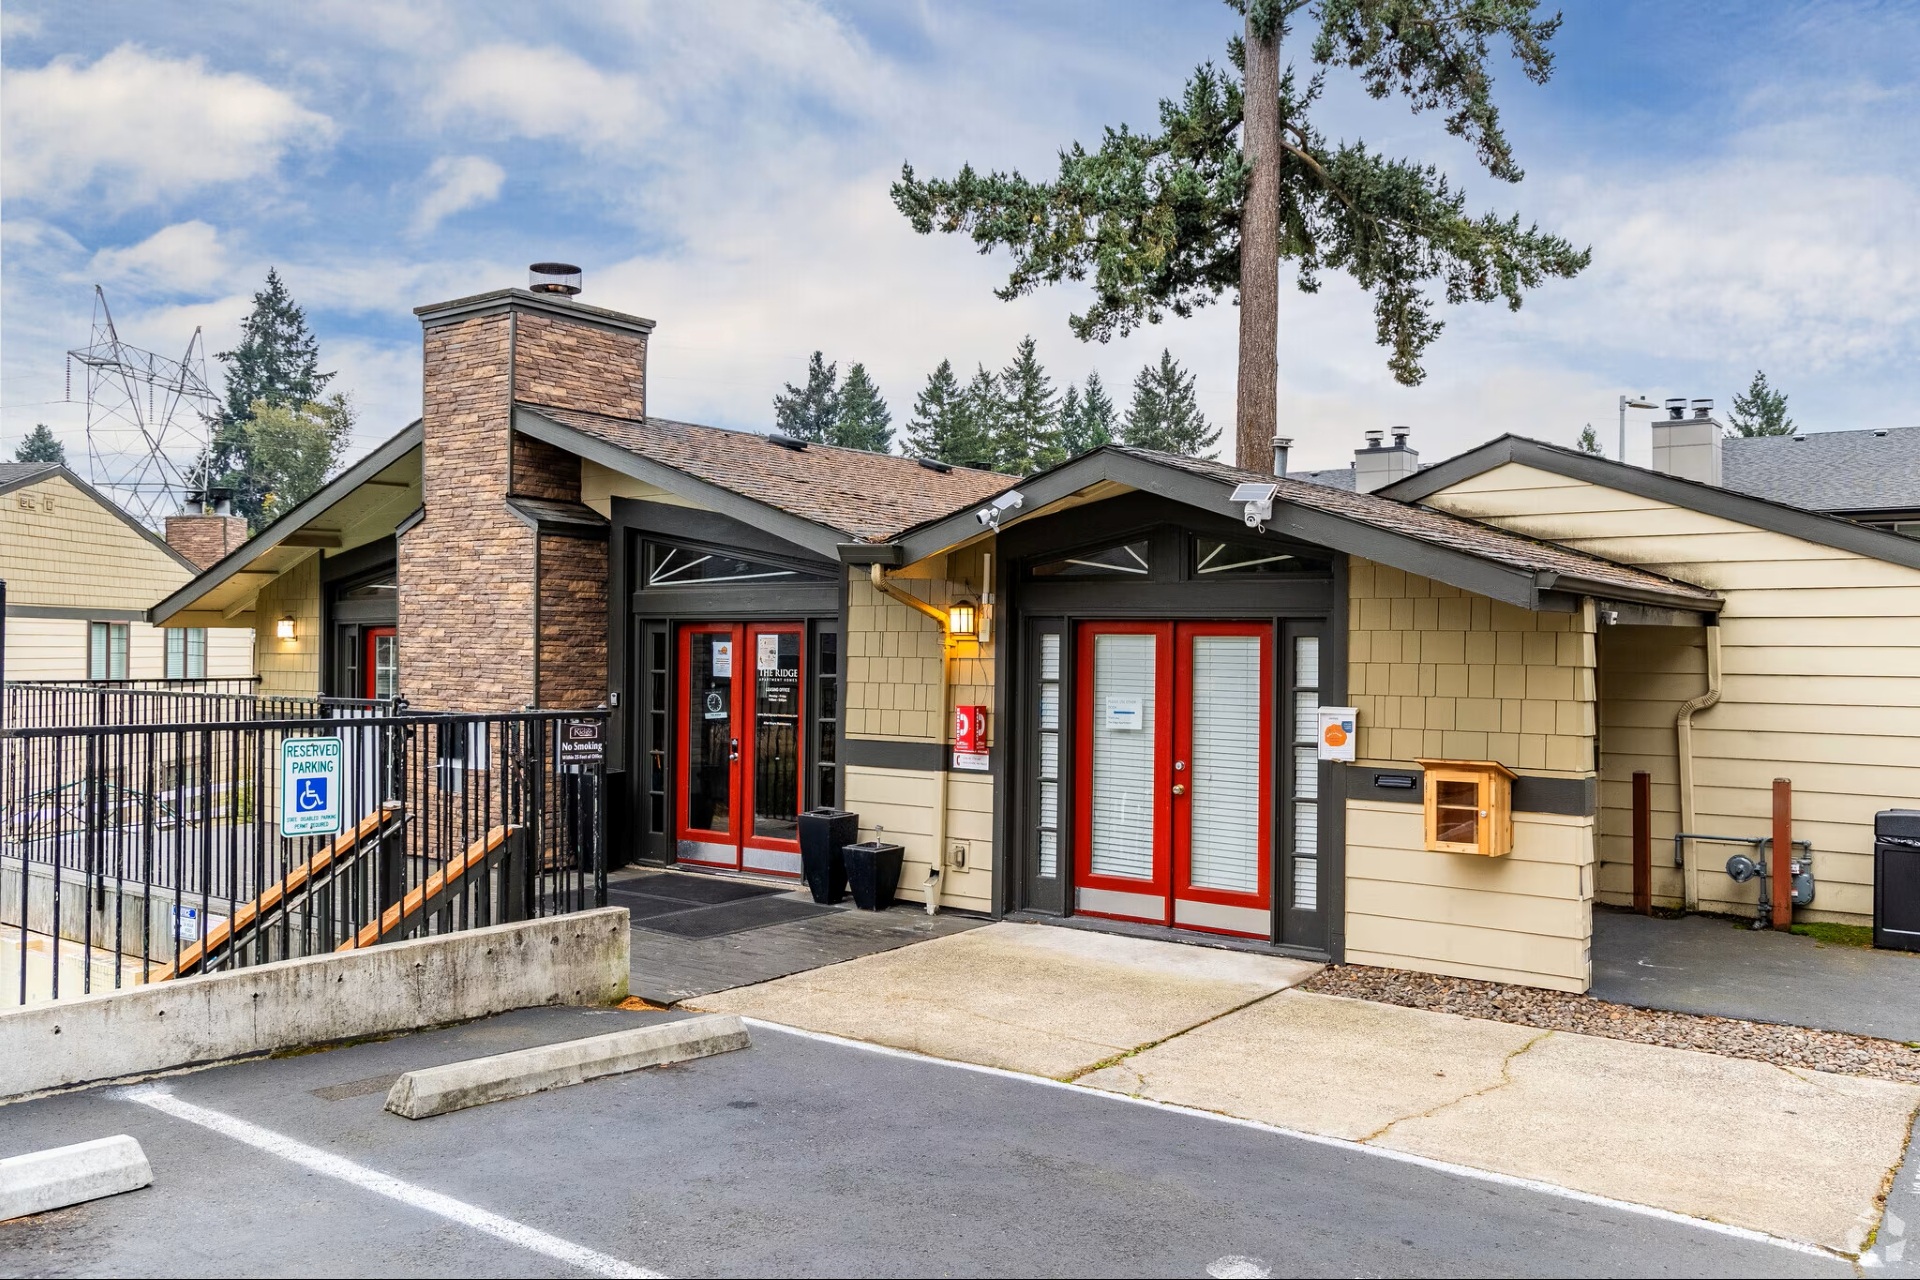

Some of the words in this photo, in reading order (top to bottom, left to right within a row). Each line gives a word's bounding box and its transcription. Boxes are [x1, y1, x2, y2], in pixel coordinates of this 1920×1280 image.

[775, 669, 798, 677] RIDGE
[287, 744, 338, 757] RESERVED
[562, 742, 572, 751] No
[574, 741, 602, 752] Smoking
[292, 760, 334, 774] PARKING
